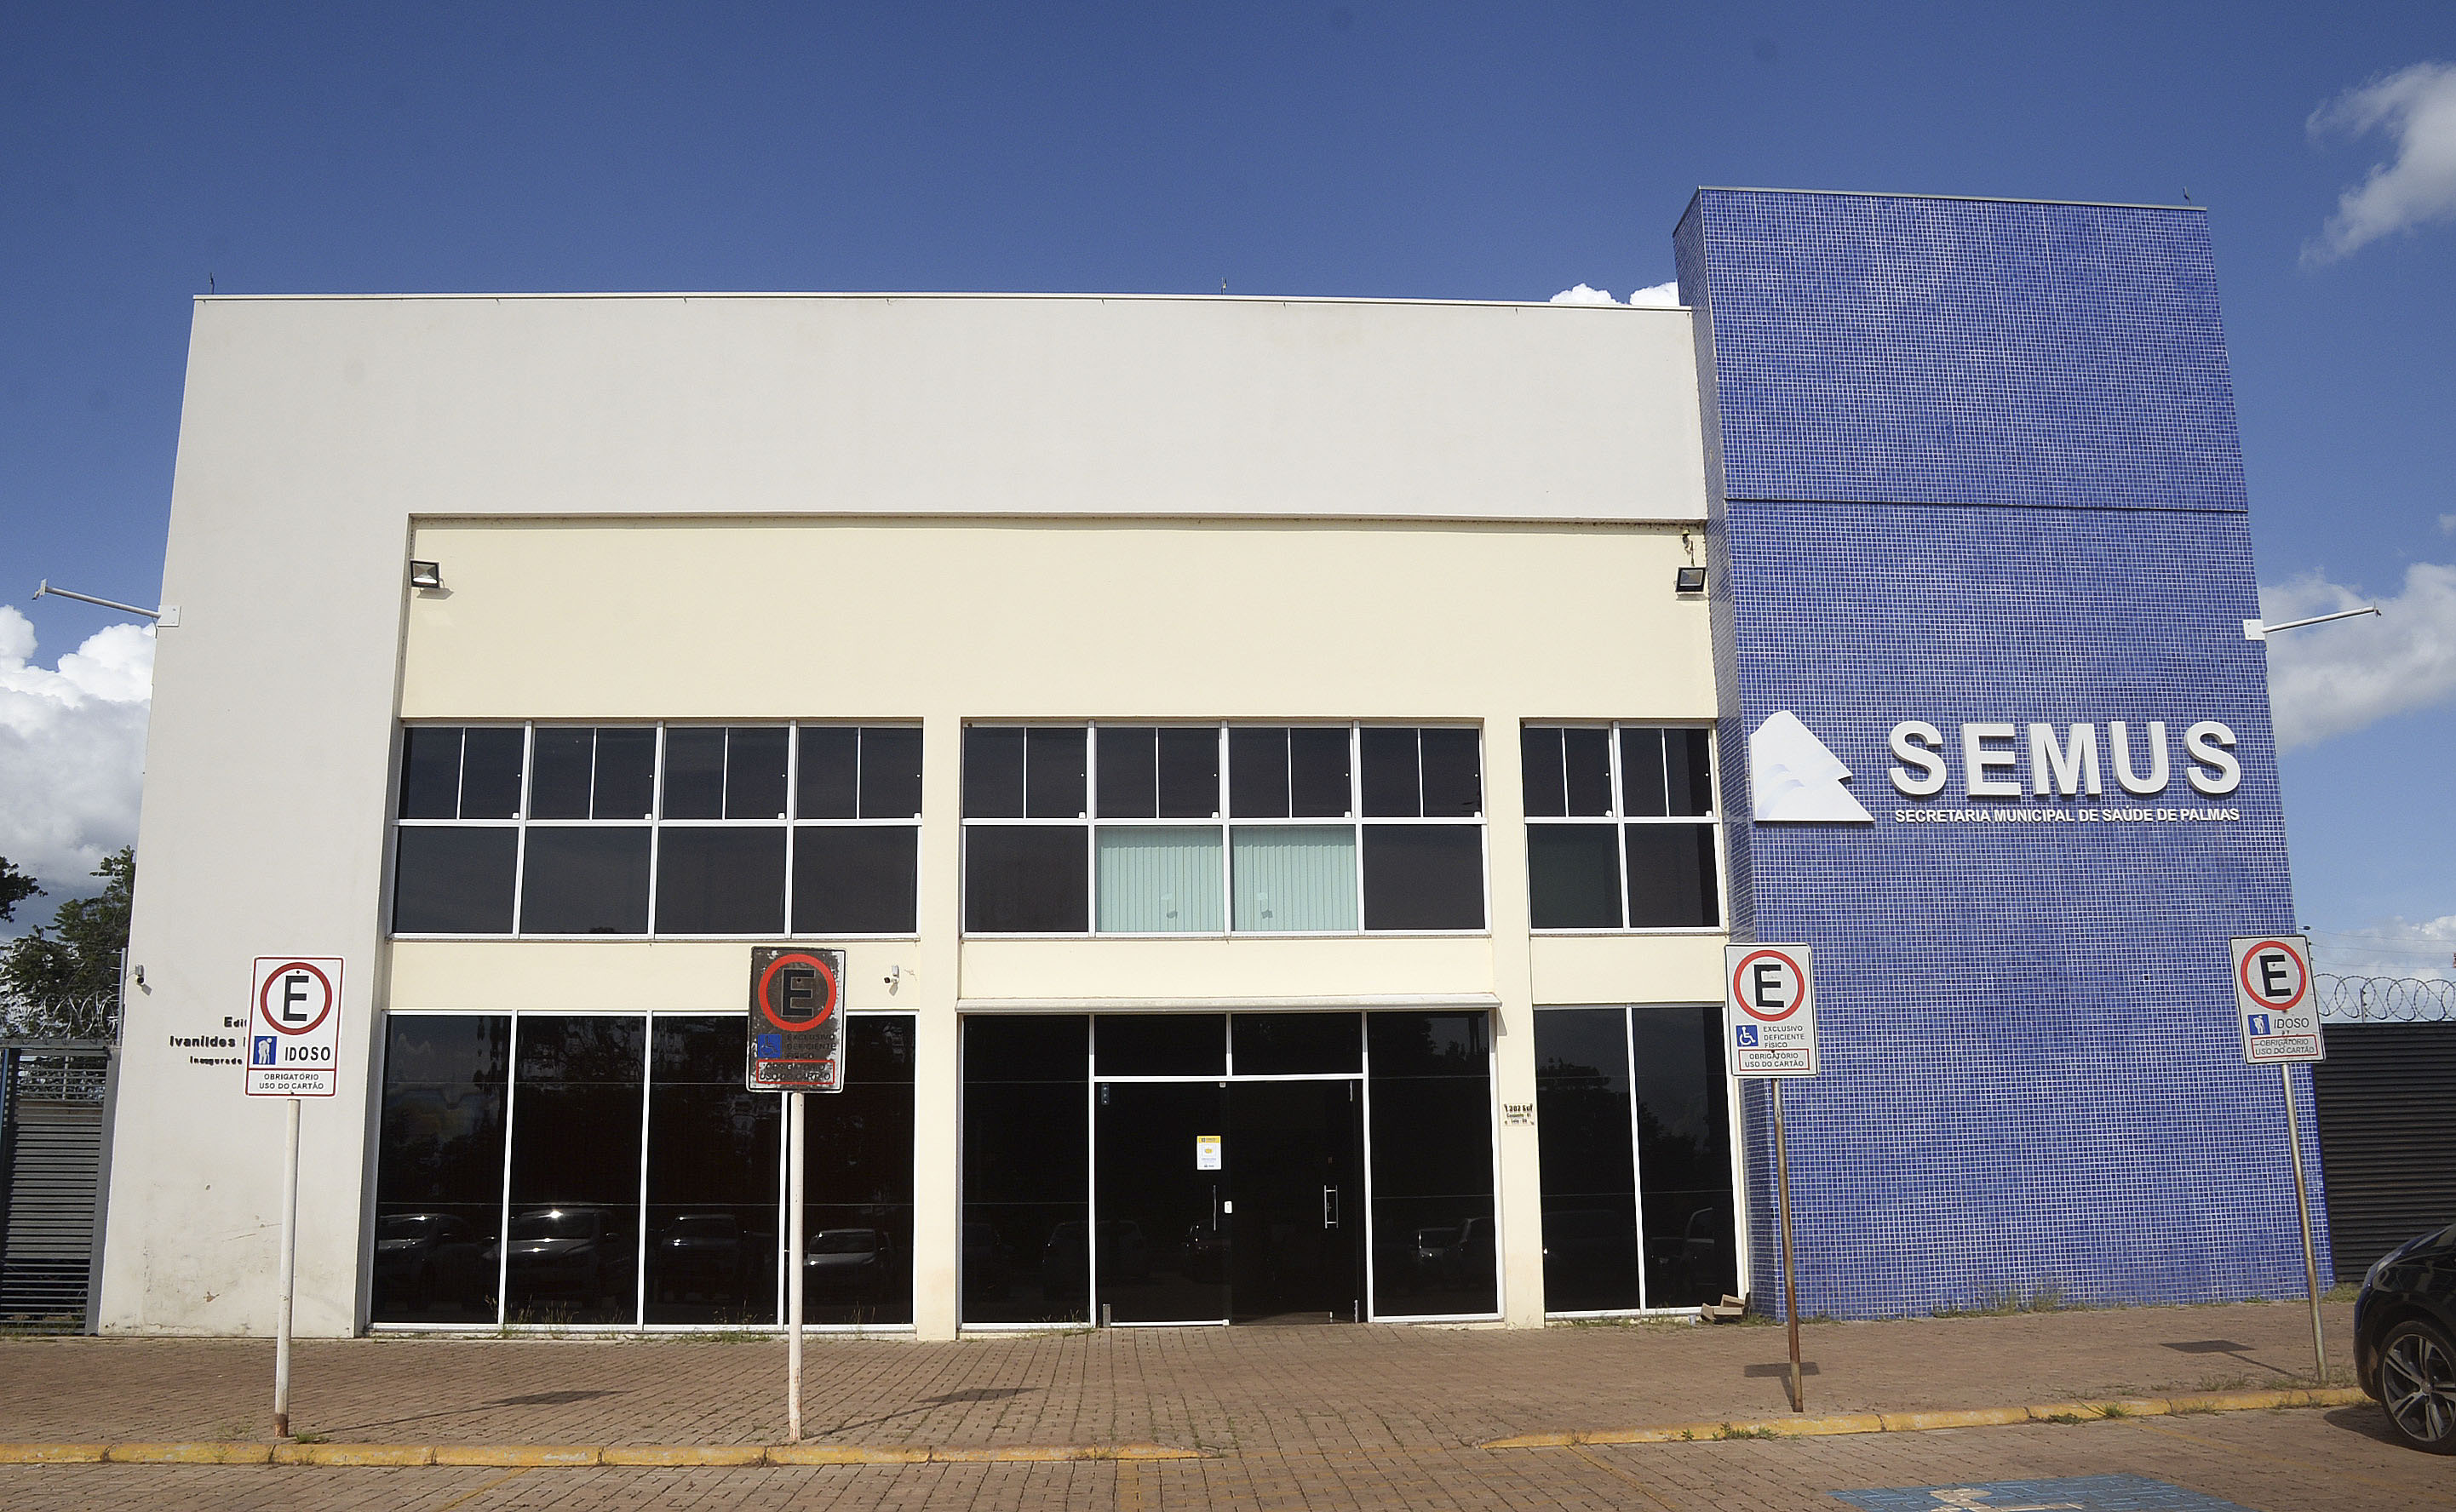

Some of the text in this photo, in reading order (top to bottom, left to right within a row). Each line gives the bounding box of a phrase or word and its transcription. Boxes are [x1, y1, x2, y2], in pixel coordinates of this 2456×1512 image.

[1889, 720, 2241, 796] SEMUS
[1895, 805, 2240, 822] SECRETARIA MUNICIPAL DE SAÚDE DE PALMAS
[2259, 954, 2292, 997] E
[782, 968, 815, 1017] E
[1753, 964, 1785, 1008] E
[282, 975, 309, 1021] E
[2274, 1017, 2310, 1028] IDOSO
[284, 1046, 331, 1061] IDOSO
[2287, 1045, 2315, 1054] CARTÃO
[264, 1072, 319, 1080] OBRIGATÓRIO
[291, 1081, 324, 1090] CARTÃO
